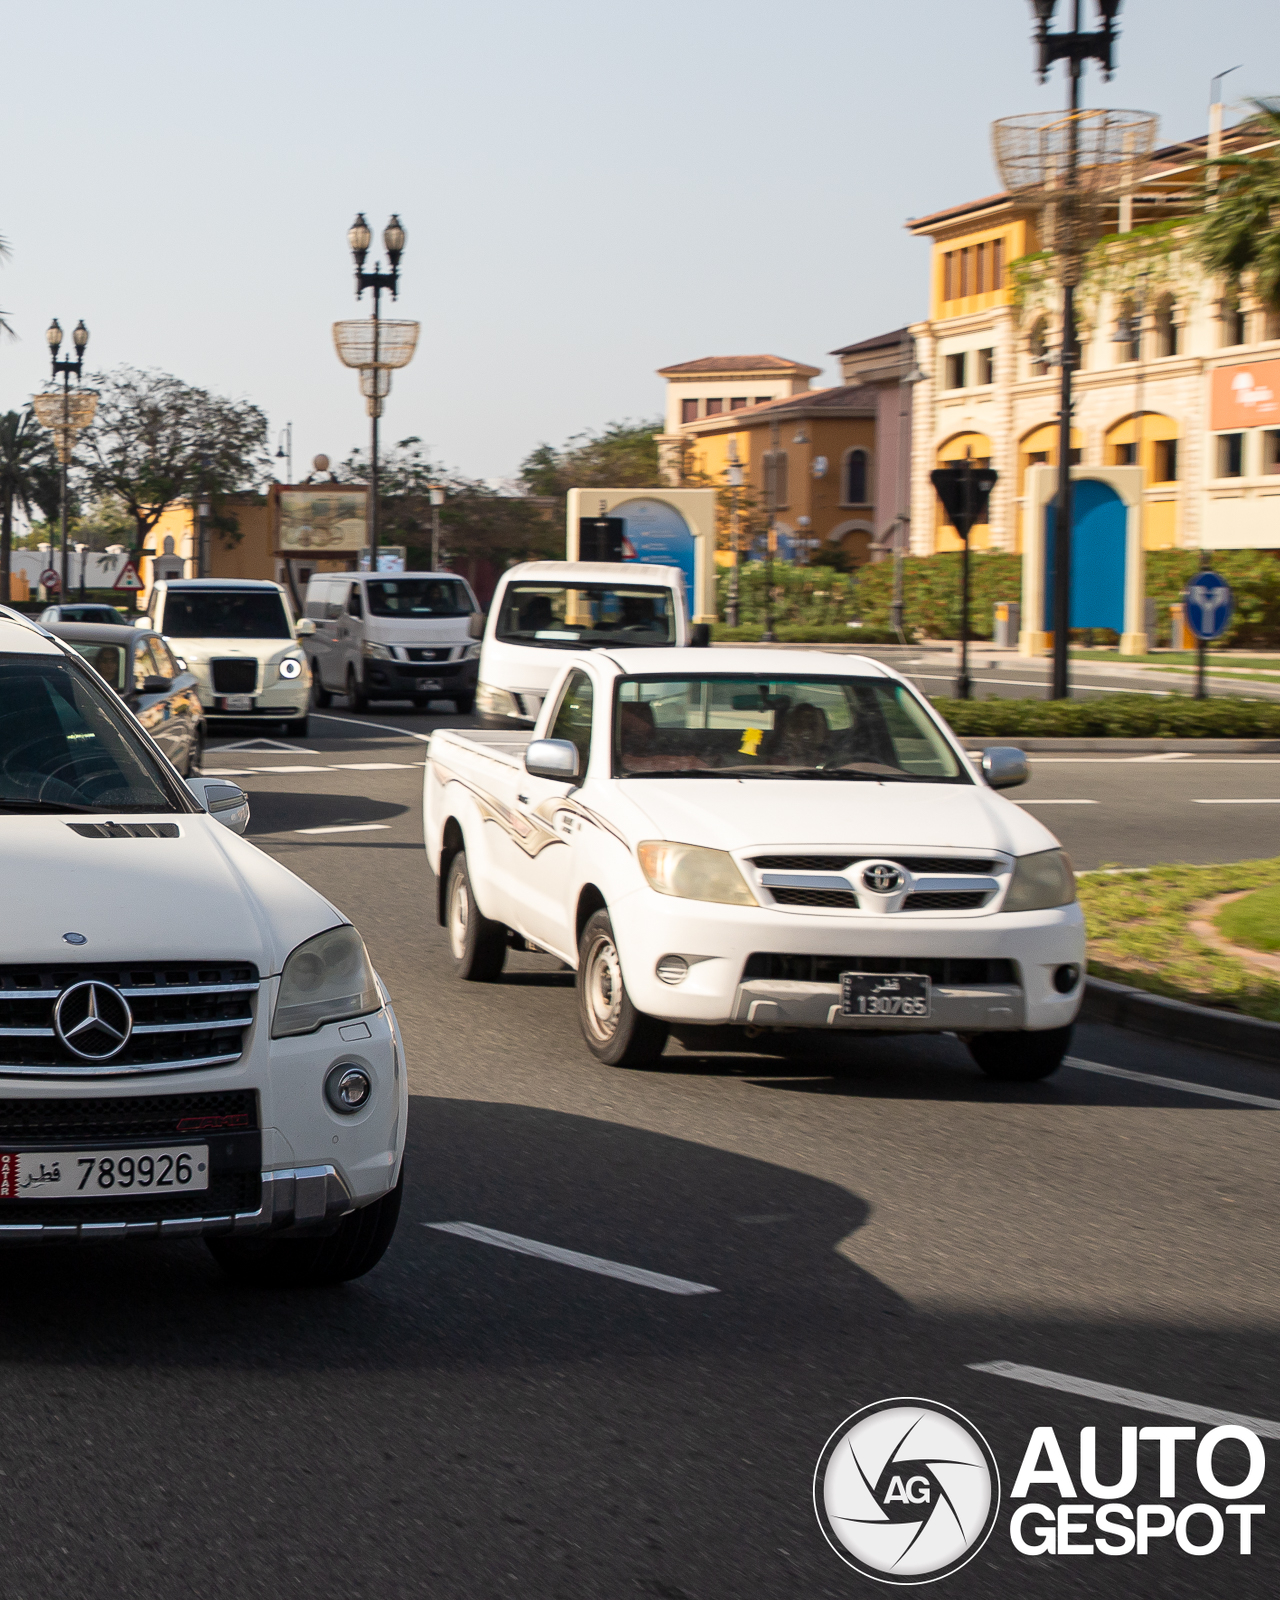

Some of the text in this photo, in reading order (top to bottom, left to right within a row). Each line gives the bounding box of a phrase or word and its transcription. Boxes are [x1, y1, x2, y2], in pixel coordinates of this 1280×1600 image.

[0, 1155, 10, 1196] QATAR
[19, 1161, 61, 1188] قطر
[77, 1152, 193, 1190] 789926
